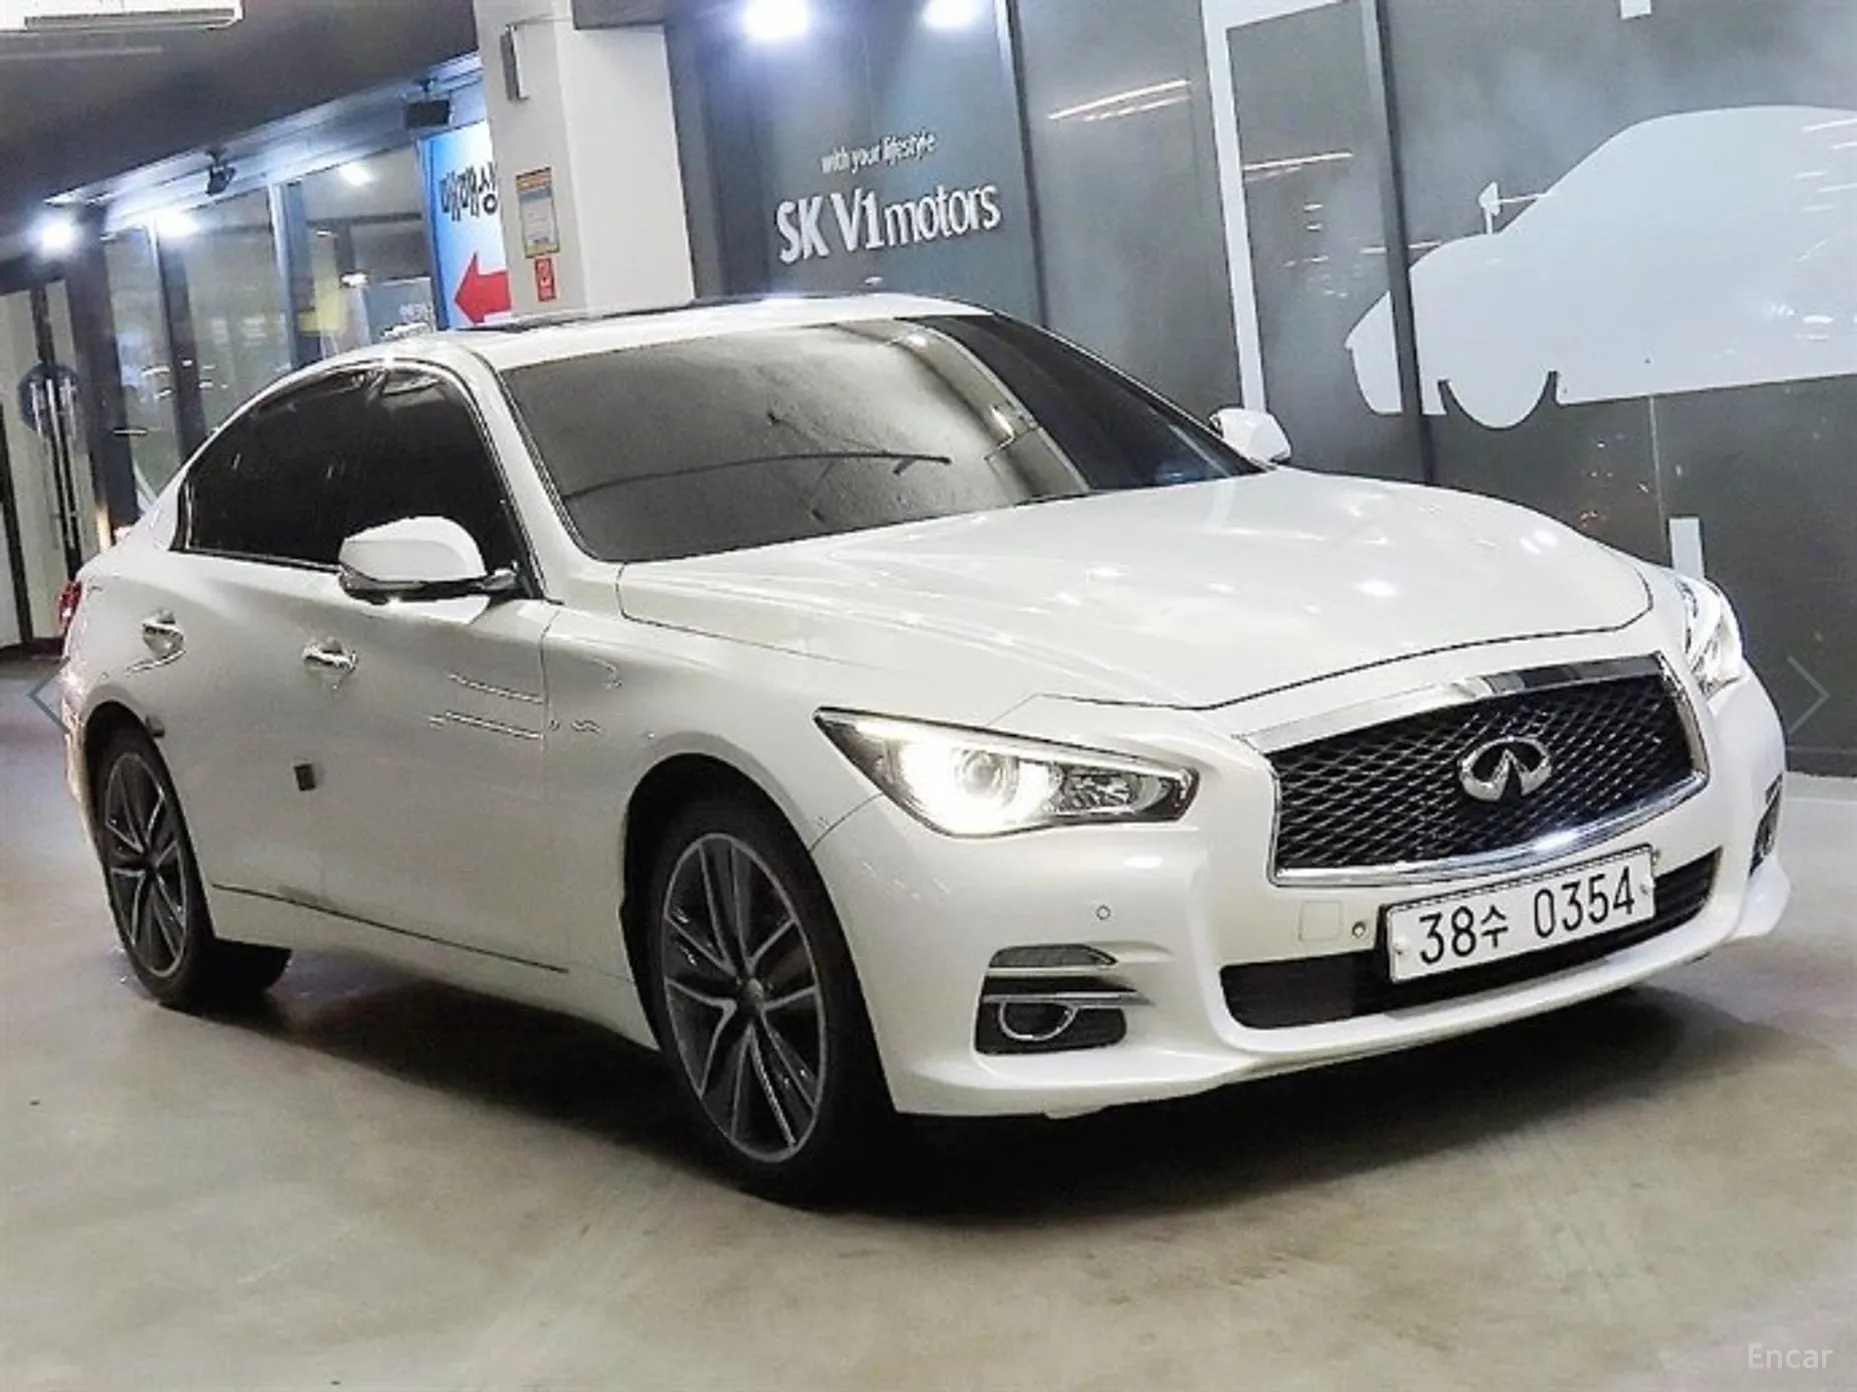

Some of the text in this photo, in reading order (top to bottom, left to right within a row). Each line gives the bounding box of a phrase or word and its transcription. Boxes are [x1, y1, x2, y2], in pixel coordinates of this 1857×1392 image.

[820, 127, 937, 175] with your lifestyle
[776, 195, 830, 263] SK
[1418, 865, 1636, 965] 38수 0354
